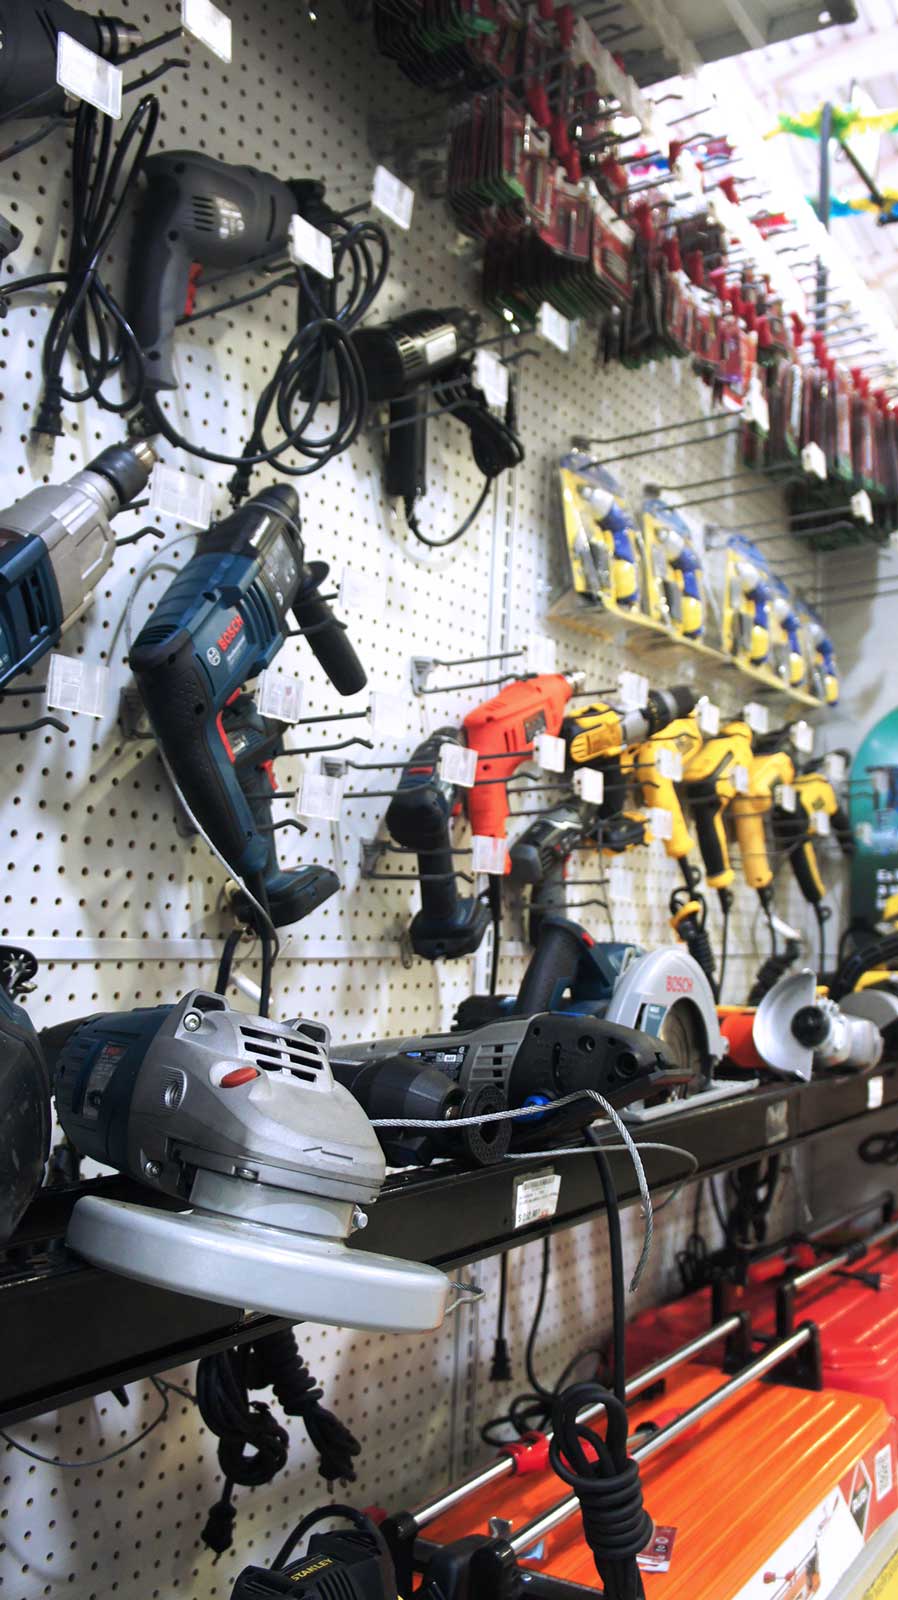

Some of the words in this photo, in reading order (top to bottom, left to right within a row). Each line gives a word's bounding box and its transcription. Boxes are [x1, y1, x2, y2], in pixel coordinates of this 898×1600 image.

[217, 614, 244, 652] BOSCH
[666, 975, 693, 992] BOSCH
[291, 1558, 333, 1581] STANLEY
